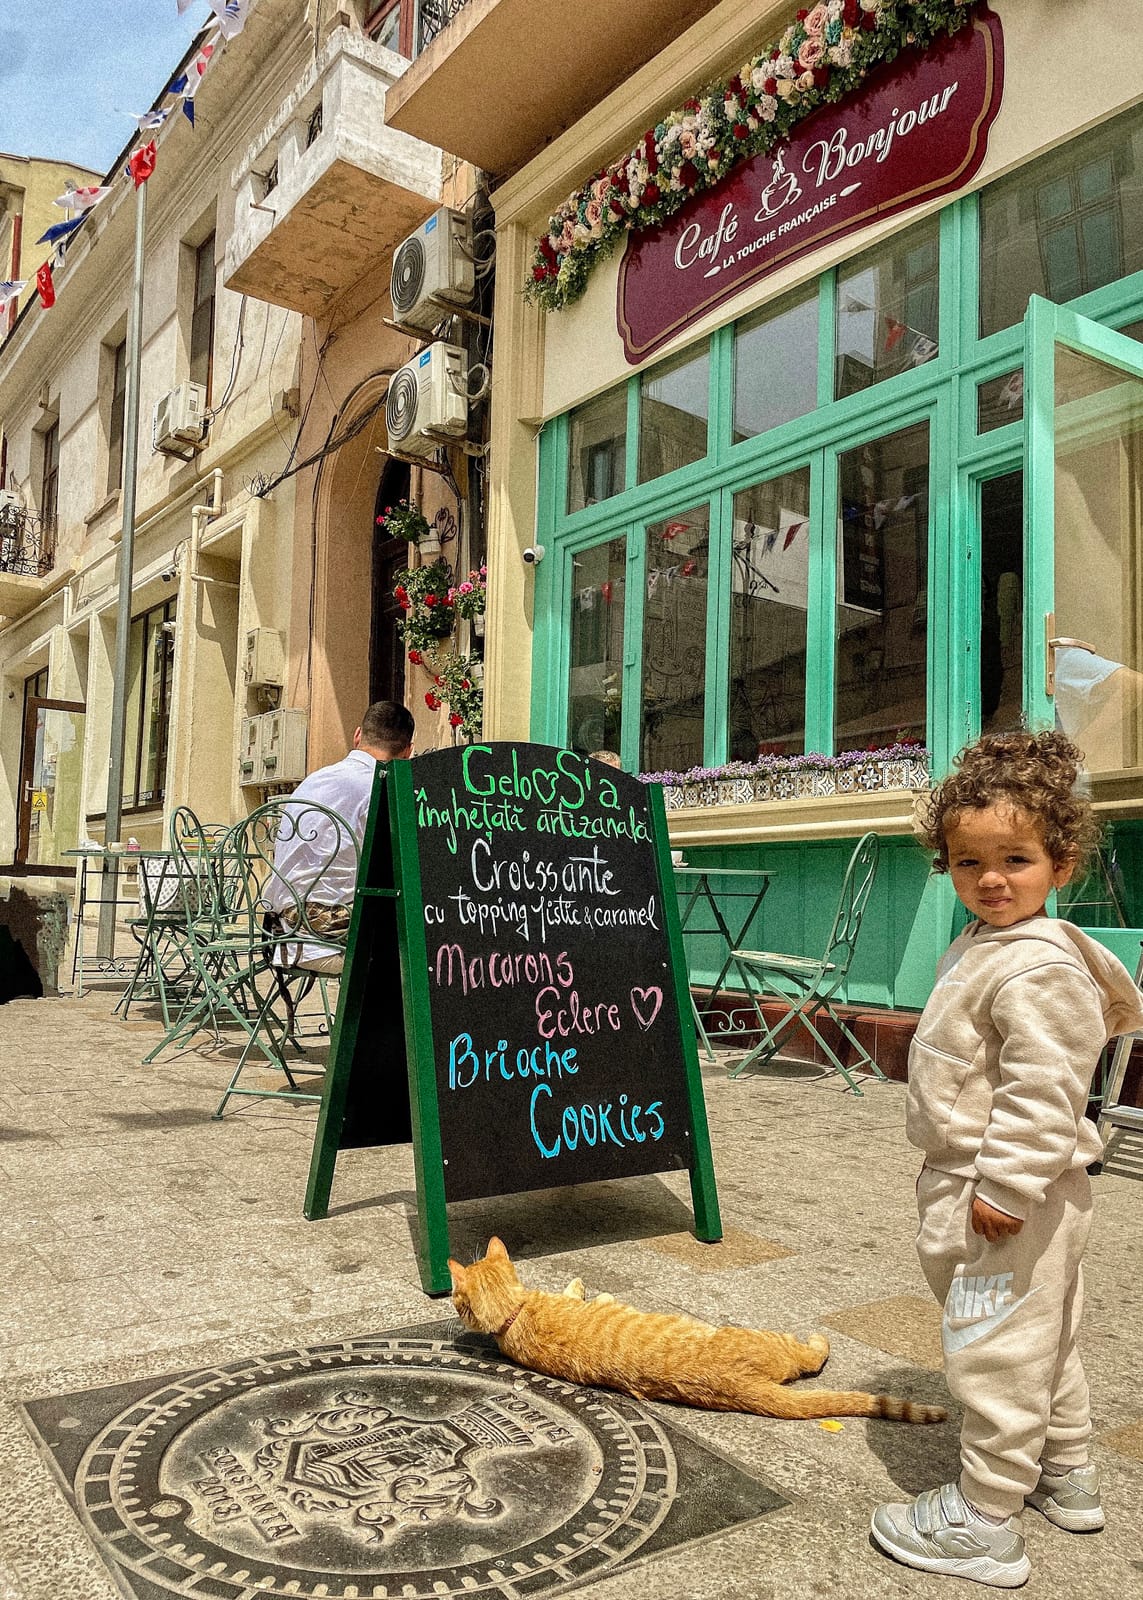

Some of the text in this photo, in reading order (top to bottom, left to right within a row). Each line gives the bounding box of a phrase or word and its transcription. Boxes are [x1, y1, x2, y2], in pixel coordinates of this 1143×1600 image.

[674, 81, 959, 270] Café Bonjour
[722, 193, 838, 269] LA TOUCHE FRANÇAISE
[536, 802, 653, 844] artizanală
[471, 838, 621, 895] Croissante
[424, 903, 445, 925] cu
[448, 886, 530, 942] topping
[584, 906, 594, 930] &
[594, 895, 660, 931] caramel
[436, 943, 575, 996] Macarons
[535, 986, 621, 1039] Eclere
[449, 1032, 580, 1090] Brioche
[530, 1083, 665, 1160] Cookies
[949, 1271, 1014, 1318] NIKE
[193, 1476, 242, 1518] 2013
